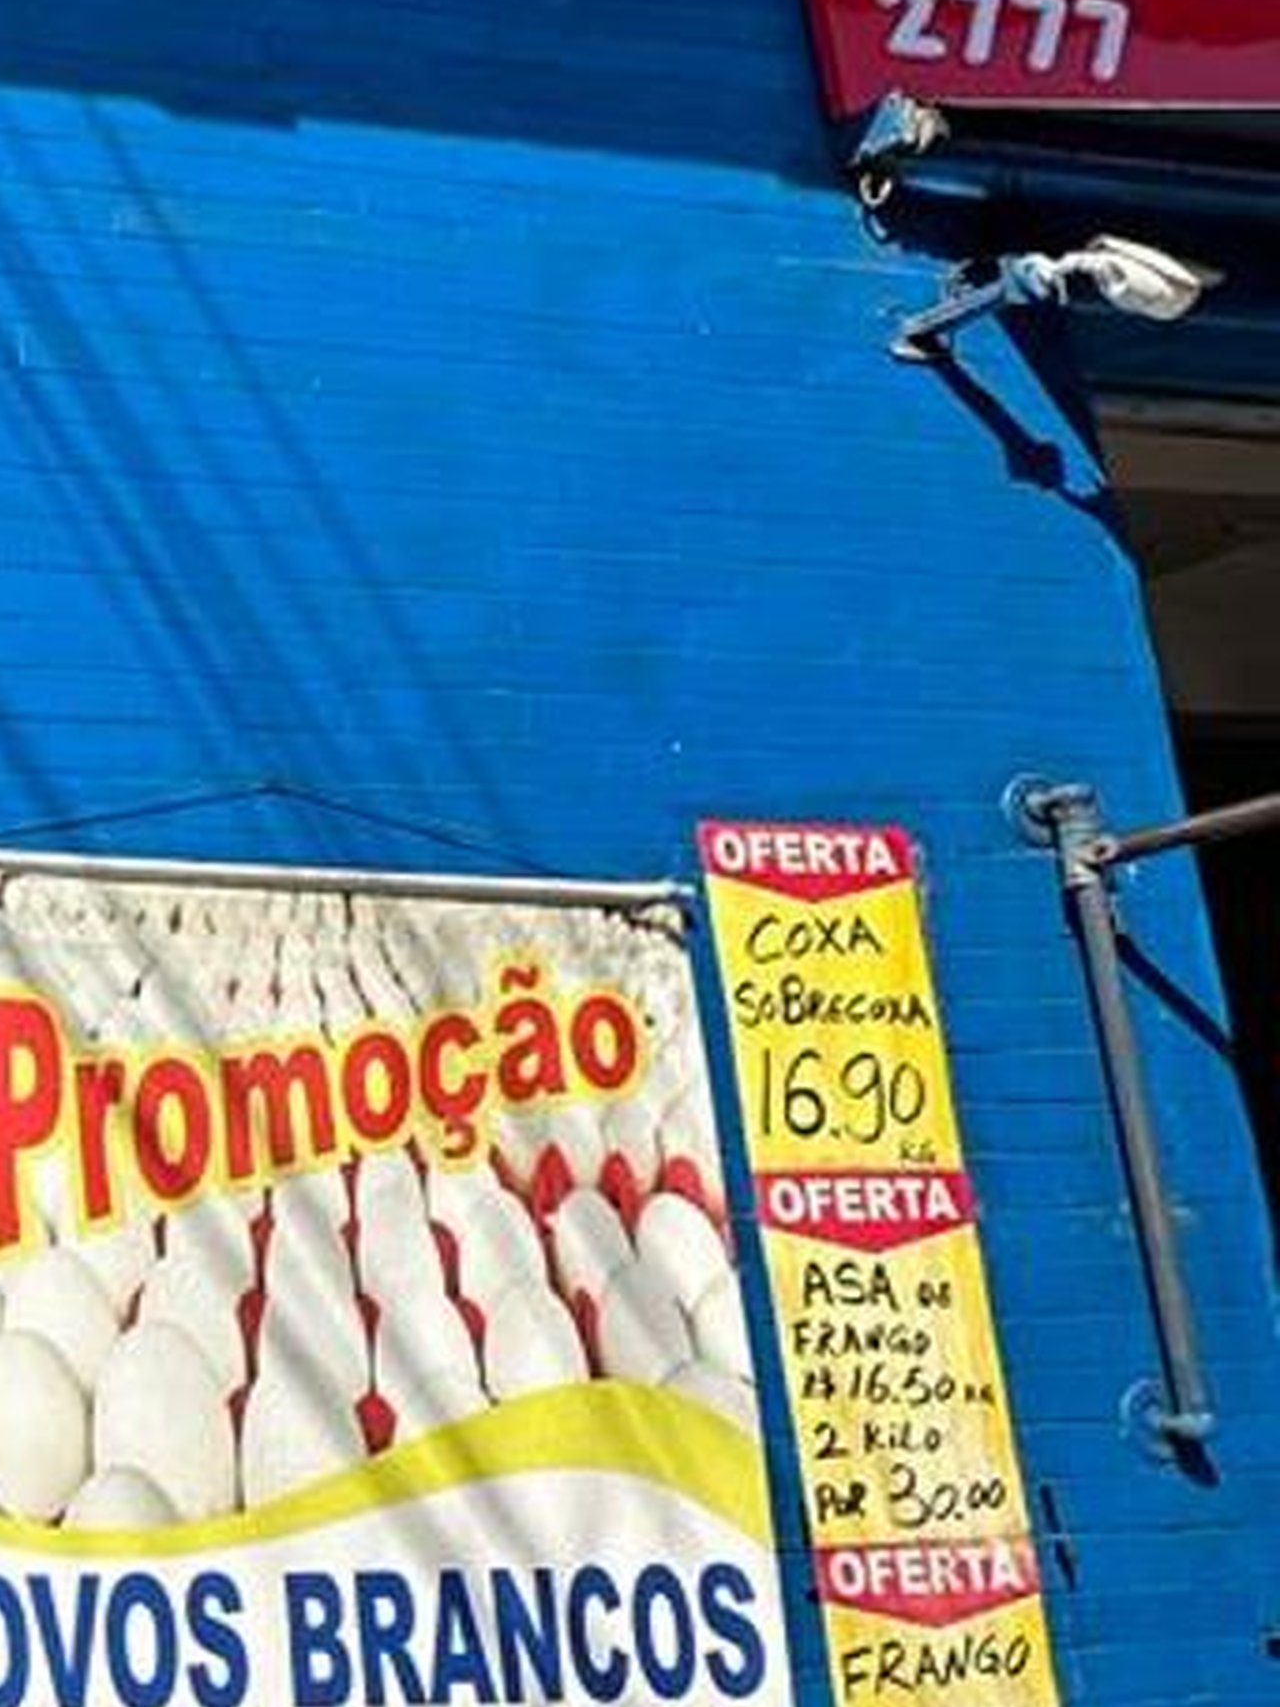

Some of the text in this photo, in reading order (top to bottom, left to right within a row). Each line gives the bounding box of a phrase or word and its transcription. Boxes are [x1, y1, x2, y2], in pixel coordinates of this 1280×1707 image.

[712, 831, 898, 875] OFERTA
[747, 916, 882, 964] COXA
[763, 1048, 925, 1144] 16.90
[770, 1178, 959, 1222] OFERTA
[803, 1261, 900, 1312] ASA
[814, 1422, 848, 1459] 2
[890, 1462, 1006, 1528] 30.00
[829, 1541, 1025, 1596] OFERTA
[841, 1633, 1030, 1699] FRANGO
